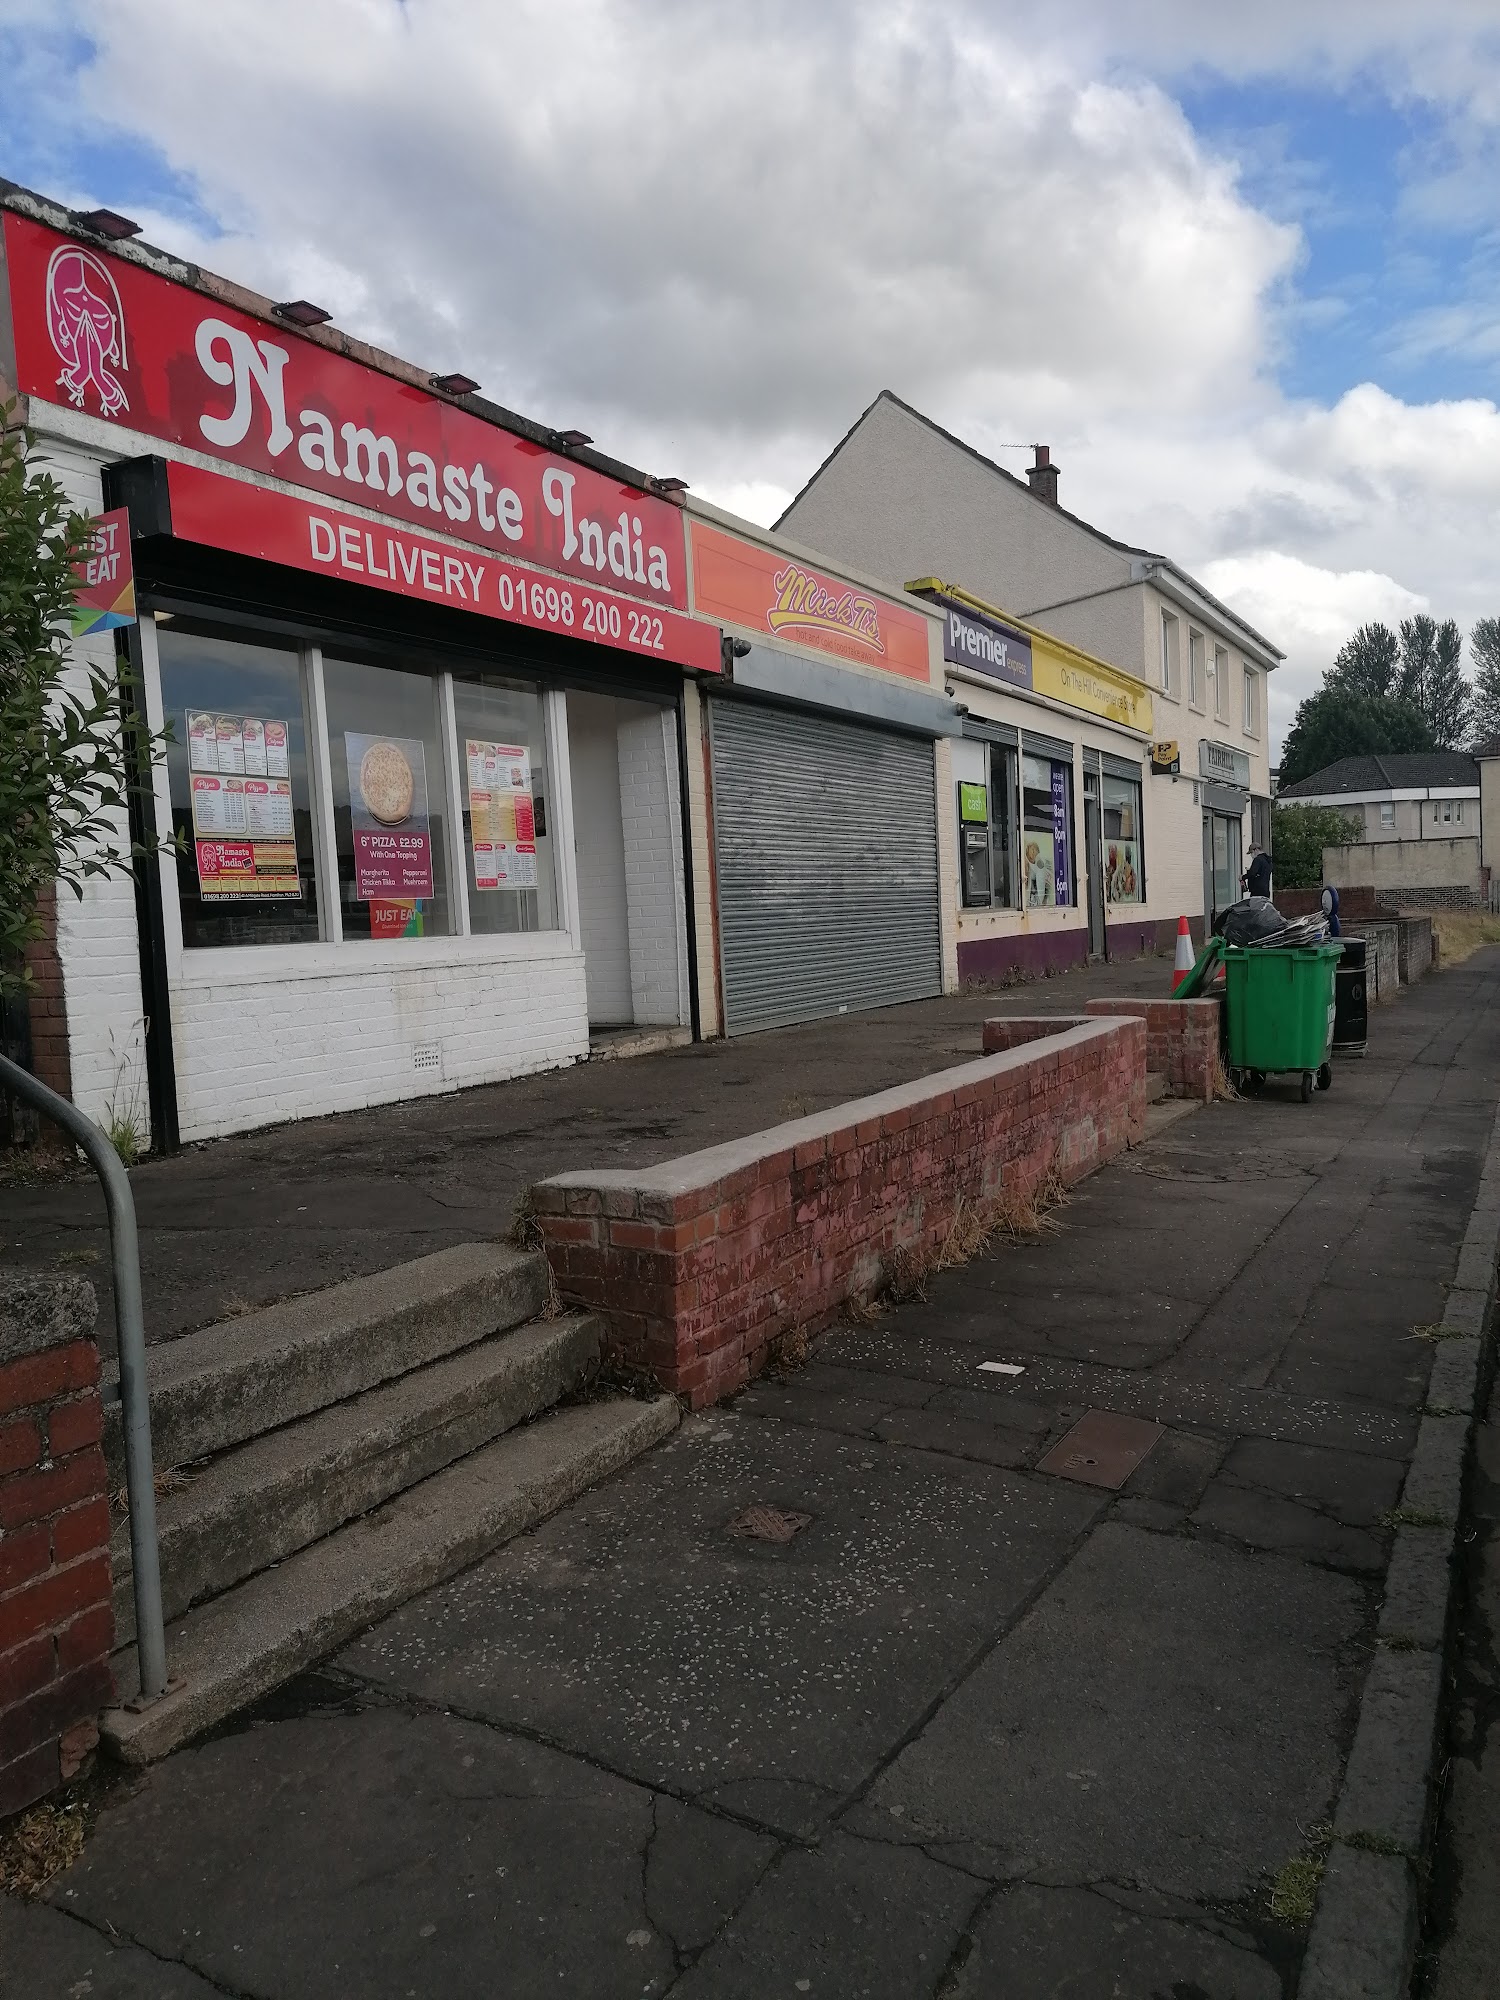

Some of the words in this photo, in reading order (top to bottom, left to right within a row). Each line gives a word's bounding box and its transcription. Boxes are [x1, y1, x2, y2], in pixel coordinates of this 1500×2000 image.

[194, 318, 524, 541] Namaste
[542, 467, 671, 592] India
[79, 523, 119, 553] UST
[86, 552, 121, 585] EAT
[308, 515, 485, 602] DELIVERY
[498, 573, 575, 627] 01698
[581, 597, 621, 638] 200
[627, 610, 665, 650] 222
[774, 564, 854, 628] Mick
[795, 626, 807, 639] hot
[808, 633, 820, 644] and
[821, 635, 833, 649] cold
[834, 640, 848, 653] food
[848, 644, 860, 659] take
[860, 653, 875, 663] away
[950, 612, 1008, 667] Premier
[1007, 657, 1027, 676] express
[1061, 668, 1071, 687] On
[1071, 672, 1082, 692] The
[1083, 677, 1093, 695] Hill
[1093, 681, 1123, 709] Convenience
[1053, 783, 1064, 795] open
[967, 796, 983, 811] cash
[1053, 804, 1065, 818] 8am
[371, 836, 398, 848] PIZZA
[399, 837, 424, 848] £2.99
[1054, 827, 1066, 843] 8pm
[215, 844, 250, 856] Namaste
[370, 850, 385, 858] With
[384, 851, 396, 859] One
[396, 851, 418, 861] Topping
[219, 856, 243, 868] India
[361, 868, 390, 878] Margherita
[402, 868, 428, 878] Pepperoni
[361, 878, 382, 886] Chicken
[382, 878, 396, 886] Tikka
[403, 878, 428, 886] Mushroom
[1057, 878, 1068, 894] 6pm
[362, 888, 375, 896] Ham
[375, 909, 399, 924] JUST
[400, 909, 417, 921] EAT
